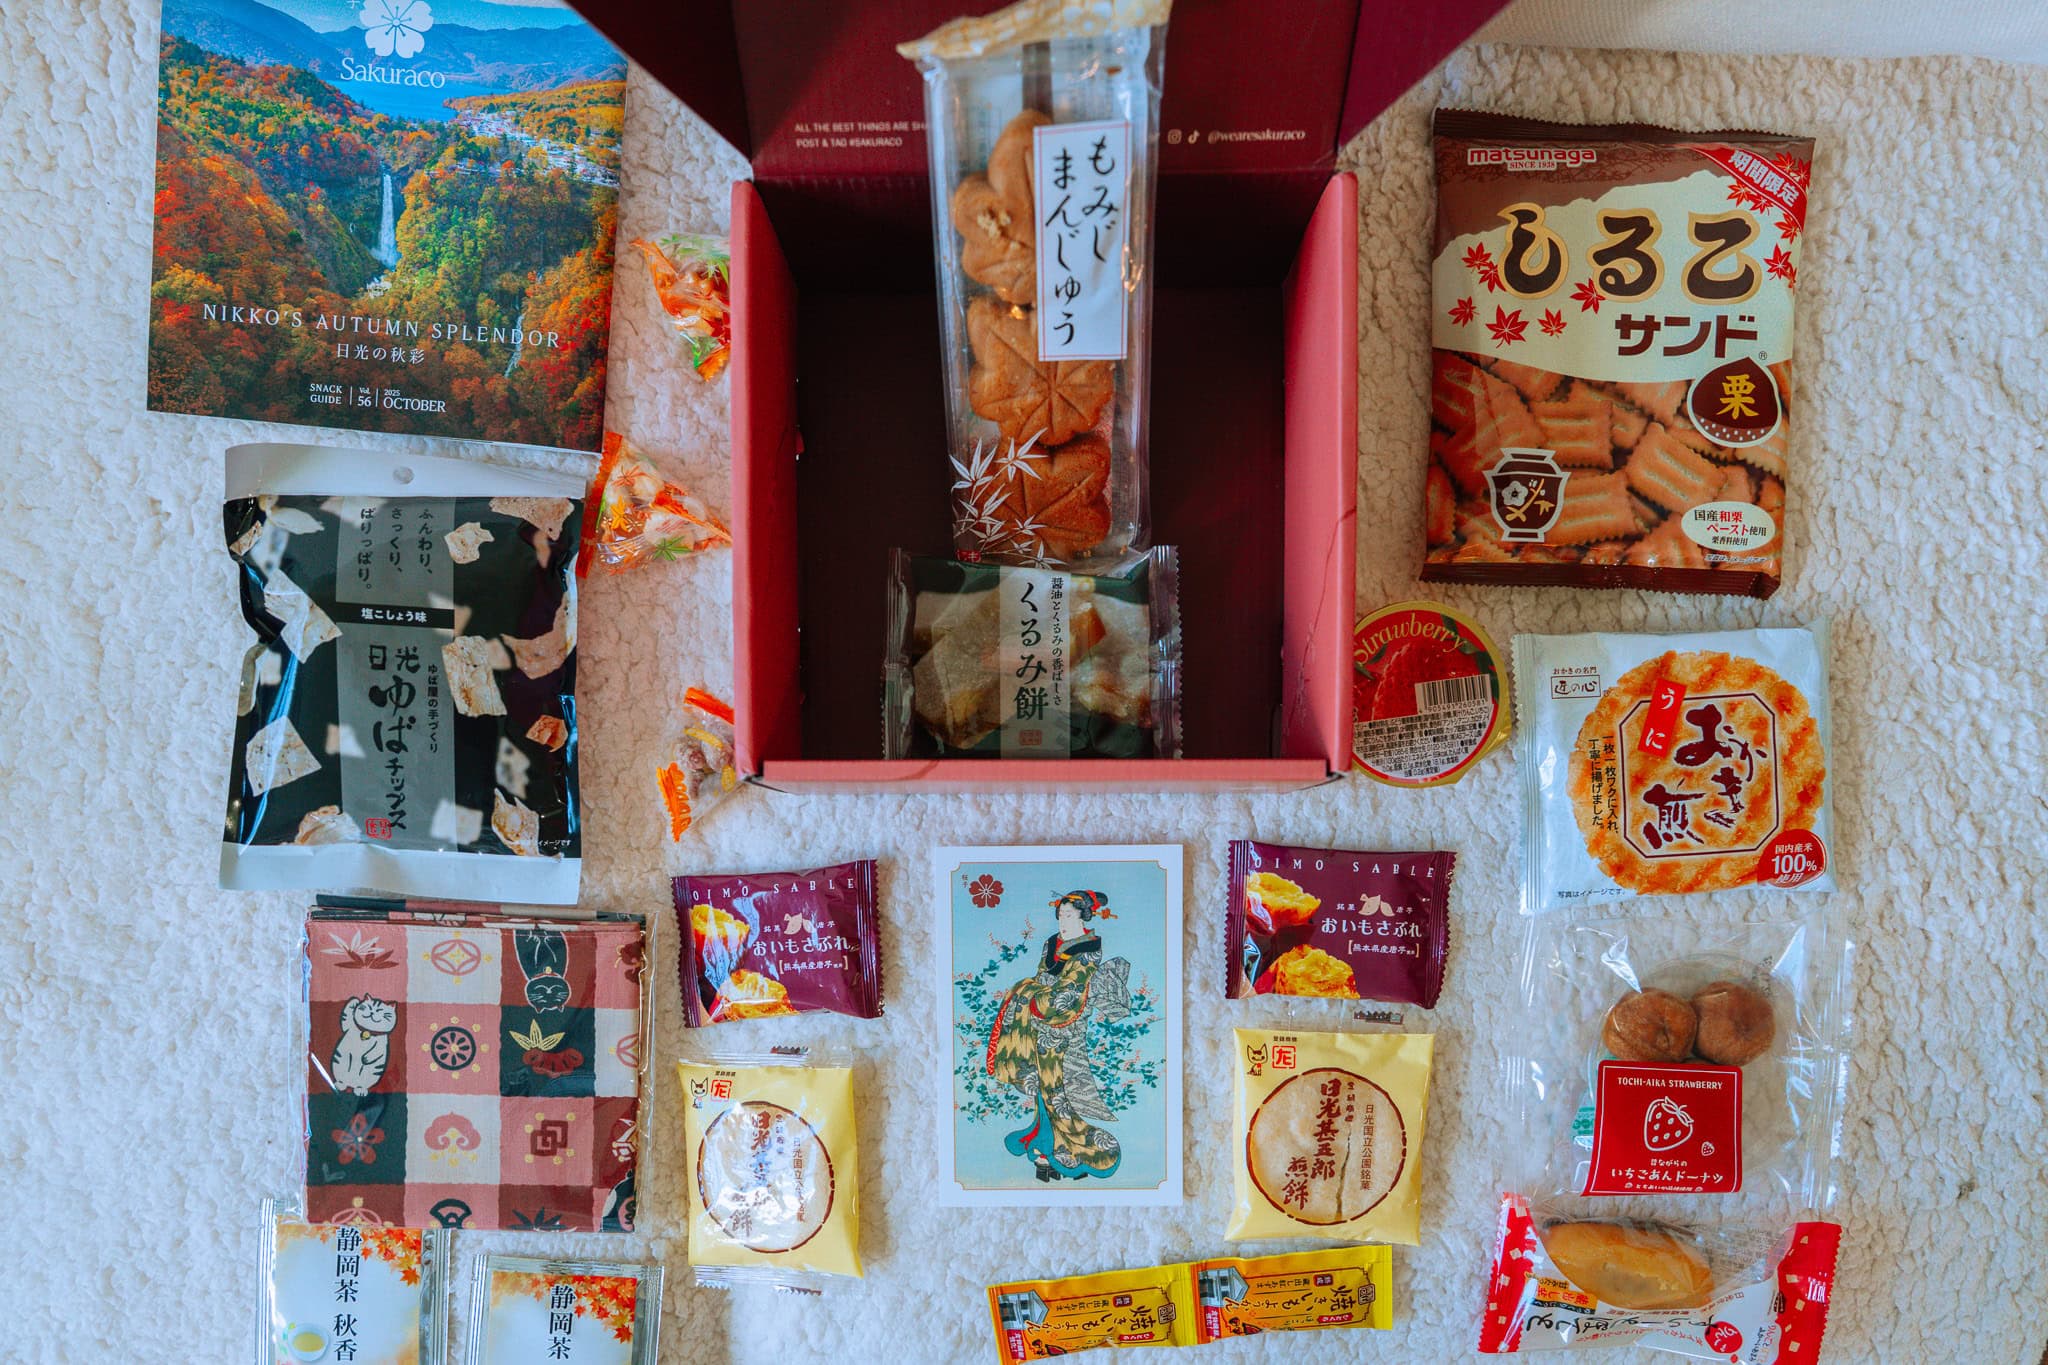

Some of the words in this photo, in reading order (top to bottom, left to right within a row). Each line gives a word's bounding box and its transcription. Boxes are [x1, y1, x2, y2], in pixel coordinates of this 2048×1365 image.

[340, 57, 446, 89] Sakuraco
[795, 123, 811, 133] ALL
[813, 122, 831, 132] THE
[832, 122, 855, 132] BEST
[857, 121, 891, 132] THINGS
[892, 121, 909, 131] ARE
[1207, 128, 1306, 144] @wearesakuraco
[796, 138, 819, 148] POST
[821, 138, 829, 147] &
[830, 138, 847, 147] TAG
[849, 136, 903, 147] #SAKURACO
[1469, 147, 1596, 165] matsunaga
[1509, 161, 1536, 169] SINCE
[1728, 149, 1800, 207] 期間限定
[1083, 135, 1121, 262] もみじ
[1044, 147, 1082, 346] まんじゅう
[1499, 204, 1761, 304] しるこ
[203, 303, 303, 329] NIKKO'S
[315, 313, 418, 337] AUTUMN
[431, 322, 559, 348] SPLENDOR
[1614, 313, 1758, 358] サンド
[336, 343, 426, 365] 日光の秋彩
[309, 383, 343, 394] SNACK
[310, 394, 342, 405] GUIDE
[1719, 373, 1760, 420] 栗
[357, 396, 372, 408] 56
[383, 397, 446, 413] OCTOBER
[1693, 509, 1743, 523] 国産和栗
[418, 508, 434, 575] ふんわり、
[1706, 523, 1767, 537] ペースト使用
[360, 607, 428, 624] 塩こしょう味
[1353, 612, 1465, 664] Strawberry
[368, 644, 421, 674] 日光
[1012, 582, 1049, 721] くるみ餅
[1553, 666, 1597, 675] おかきの名門
[1554, 679, 1598, 695] 匠の心
[427, 663, 440, 754] ゆば屋の手づくり
[1644, 685, 1676, 751] うに
[1602, 735, 1620, 834] 一枚一枚ワクに入れ、
[1775, 842, 1813, 855] 国内産米
[1253, 858, 1325, 871] OIMO
[1352, 861, 1435, 878] SABLE
[1771, 853, 1818, 875] 100%
[692, 885, 749, 902] OIMO
[773, 878, 855, 894] SABLE
[1321, 917, 1423, 938] おいもさぶれ
[752, 935, 851, 957] おいもさぶれ
[1617, 1077, 1666, 1087] TOCHI-AIKA
[1668, 1079, 1723, 1090] STRAWBERRY
[1360, 1104, 1375, 1191] 日光国立公園銘菓
[1611, 1168, 1724, 1184] いちごあんドーナツ
[334, 1227, 362, 1303] 静岡茶
[1225, 1285, 1357, 1313] 焼きいもようかん
[547, 1285, 577, 1361] 静岡茶
[1026, 1306, 1157, 1335] 焼きいもようかん
[333, 1313, 358, 1362] 秋香
